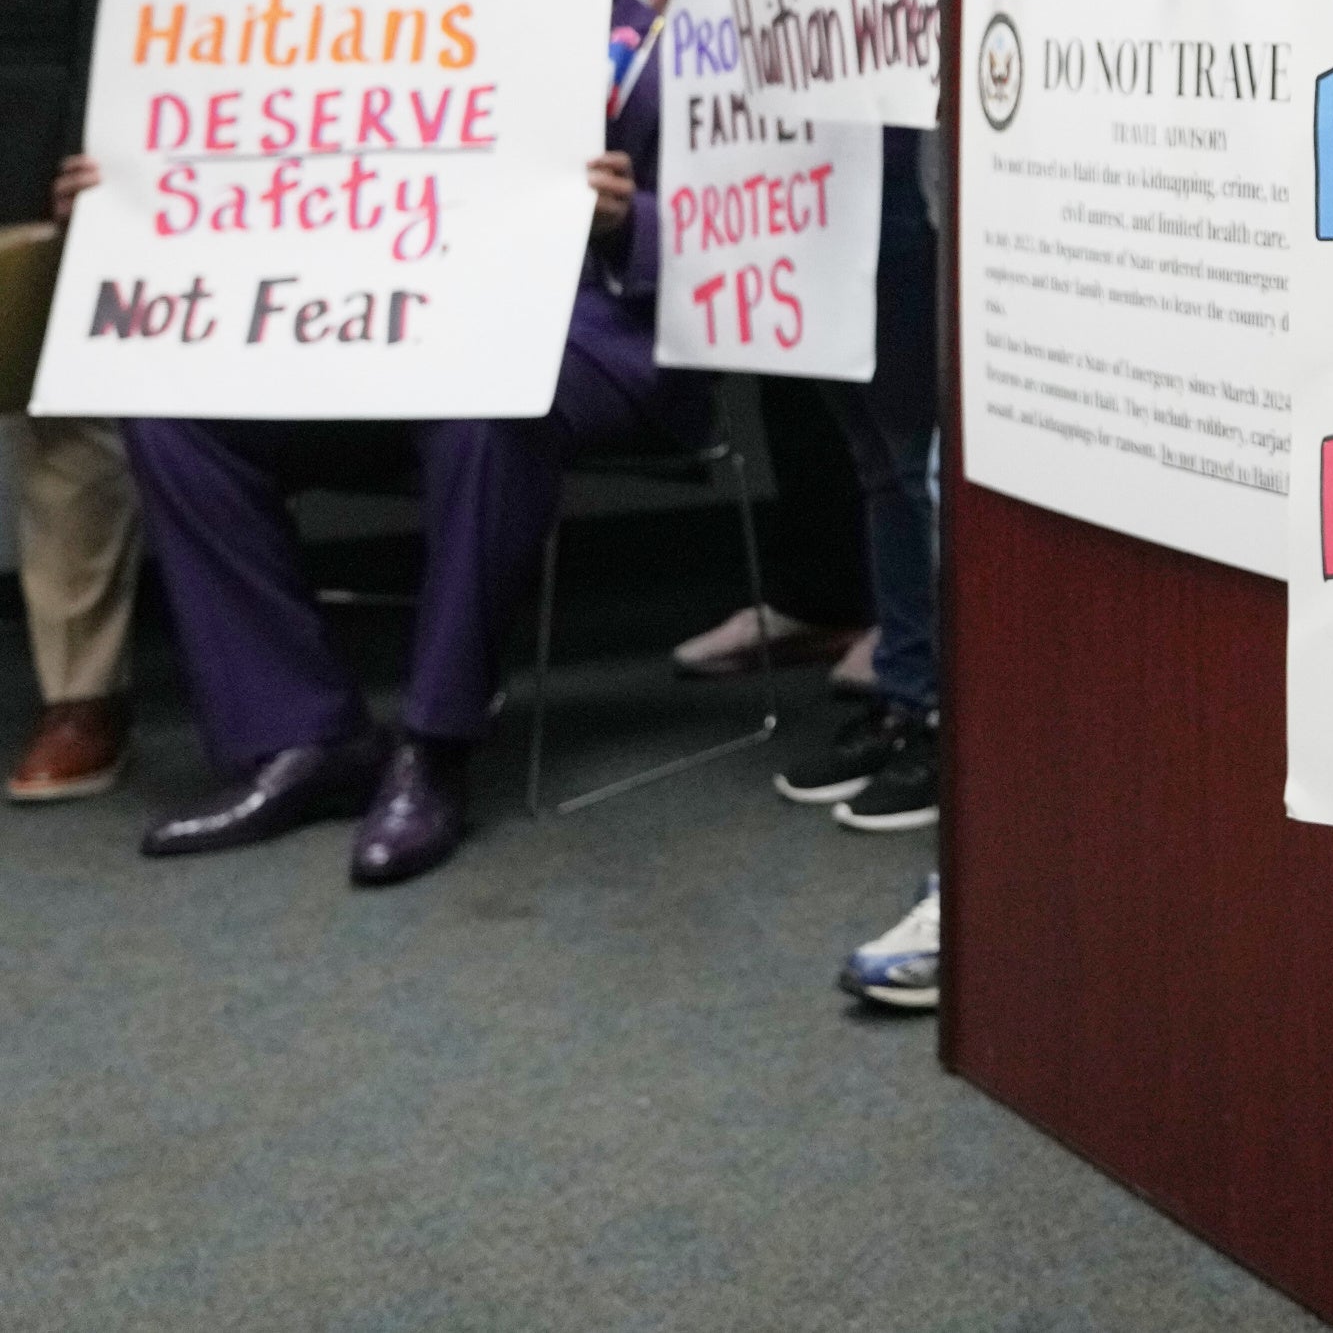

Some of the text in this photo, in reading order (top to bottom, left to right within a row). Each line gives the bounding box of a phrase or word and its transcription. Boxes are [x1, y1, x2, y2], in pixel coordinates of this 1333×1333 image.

[1042, 38, 1086, 92] DO
[1096, 40, 1162, 96] NOT
[145, 82, 499, 153] DESERVE
[1112, 120, 1229, 153] TRAVEL ADVISORY
[670, 162, 834, 255] PROTECT
[88, 274, 430, 344] Not Fear
[693, 257, 802, 351] TPS
